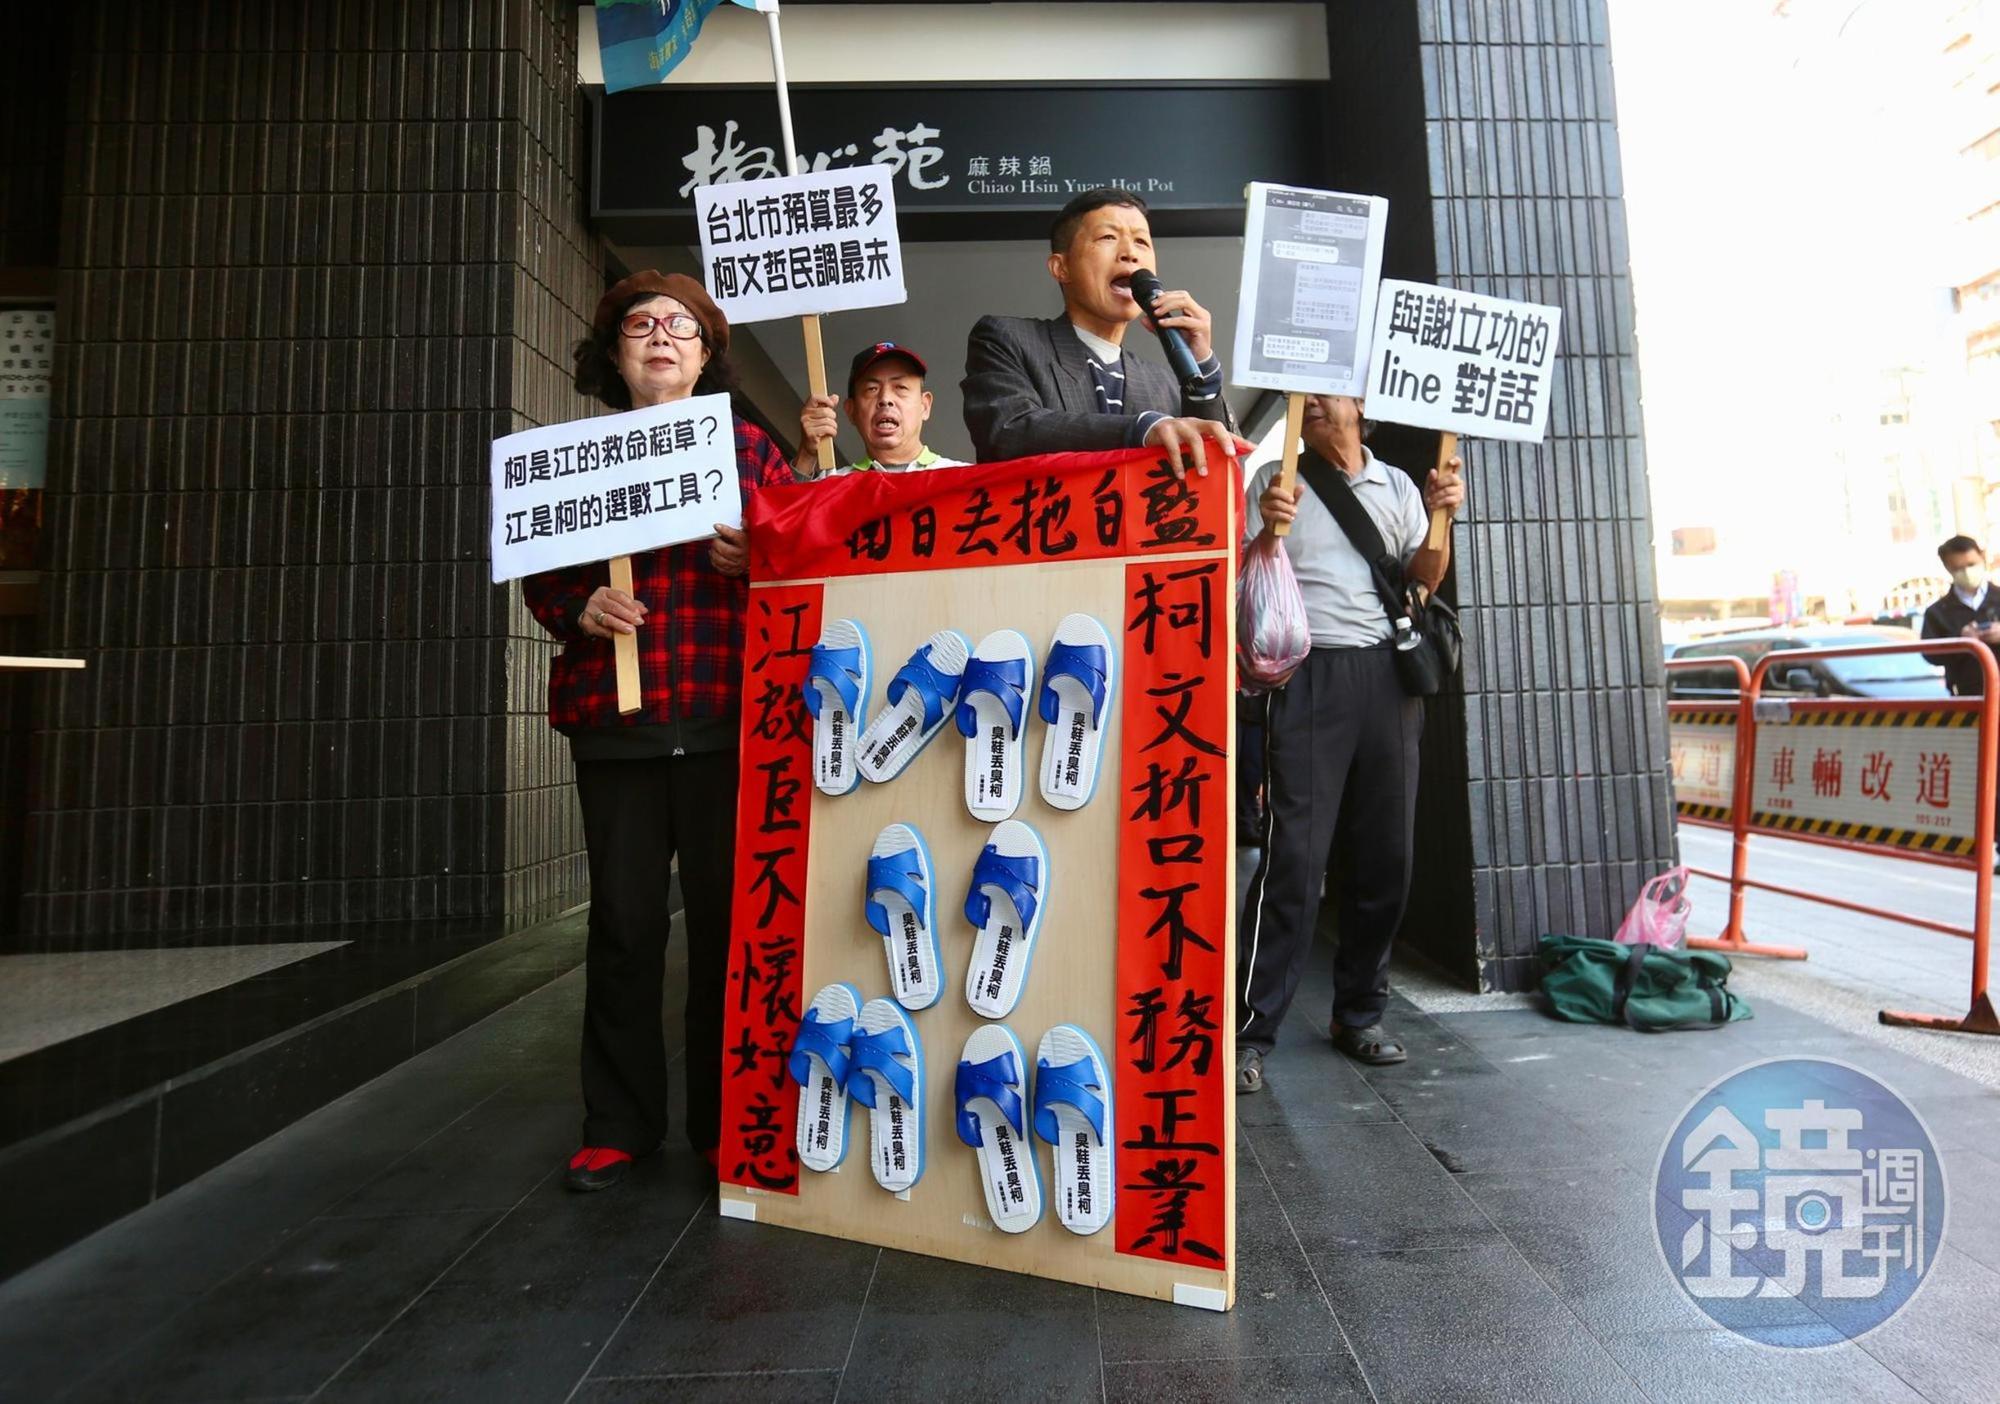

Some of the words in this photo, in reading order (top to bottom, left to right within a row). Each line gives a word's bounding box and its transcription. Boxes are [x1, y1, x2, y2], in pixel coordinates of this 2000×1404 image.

[968, 156, 1052, 176] 麻辣鍋
[968, 179, 1015, 194] Chiao
[1021, 178, 1059, 193] Hsin
[1111, 178, 1142, 192] Hot
[1148, 178, 1175, 192] Pot
[707, 183, 883, 245] 台北市預算最多
[712, 238, 891, 299] 柯文哲民調最末
[1389, 289, 1549, 367] 與謝立功的
[1379, 349, 1441, 404] line
[1451, 361, 1539, 425] 對話
[504, 416, 717, 489] 柯是江的救命稻草？
[505, 469, 724, 545] 江是柯的選戰工具？
[989, 725, 1005, 798] 臭鞋丟臭柯
[1065, 712, 1086, 786] 臭鞋丟臭柯
[1770, 746, 1953, 809] 車輛改道
[1121, 562, 1228, 1262] 柯文哲不務正業
[986, 925, 1013, 1000] 臭鞋丟臭柯
[995, 1125, 1024, 1204] 臭鞋丟臭柯
[1075, 1131, 1092, 1215] 臭鞋丟臭柯
